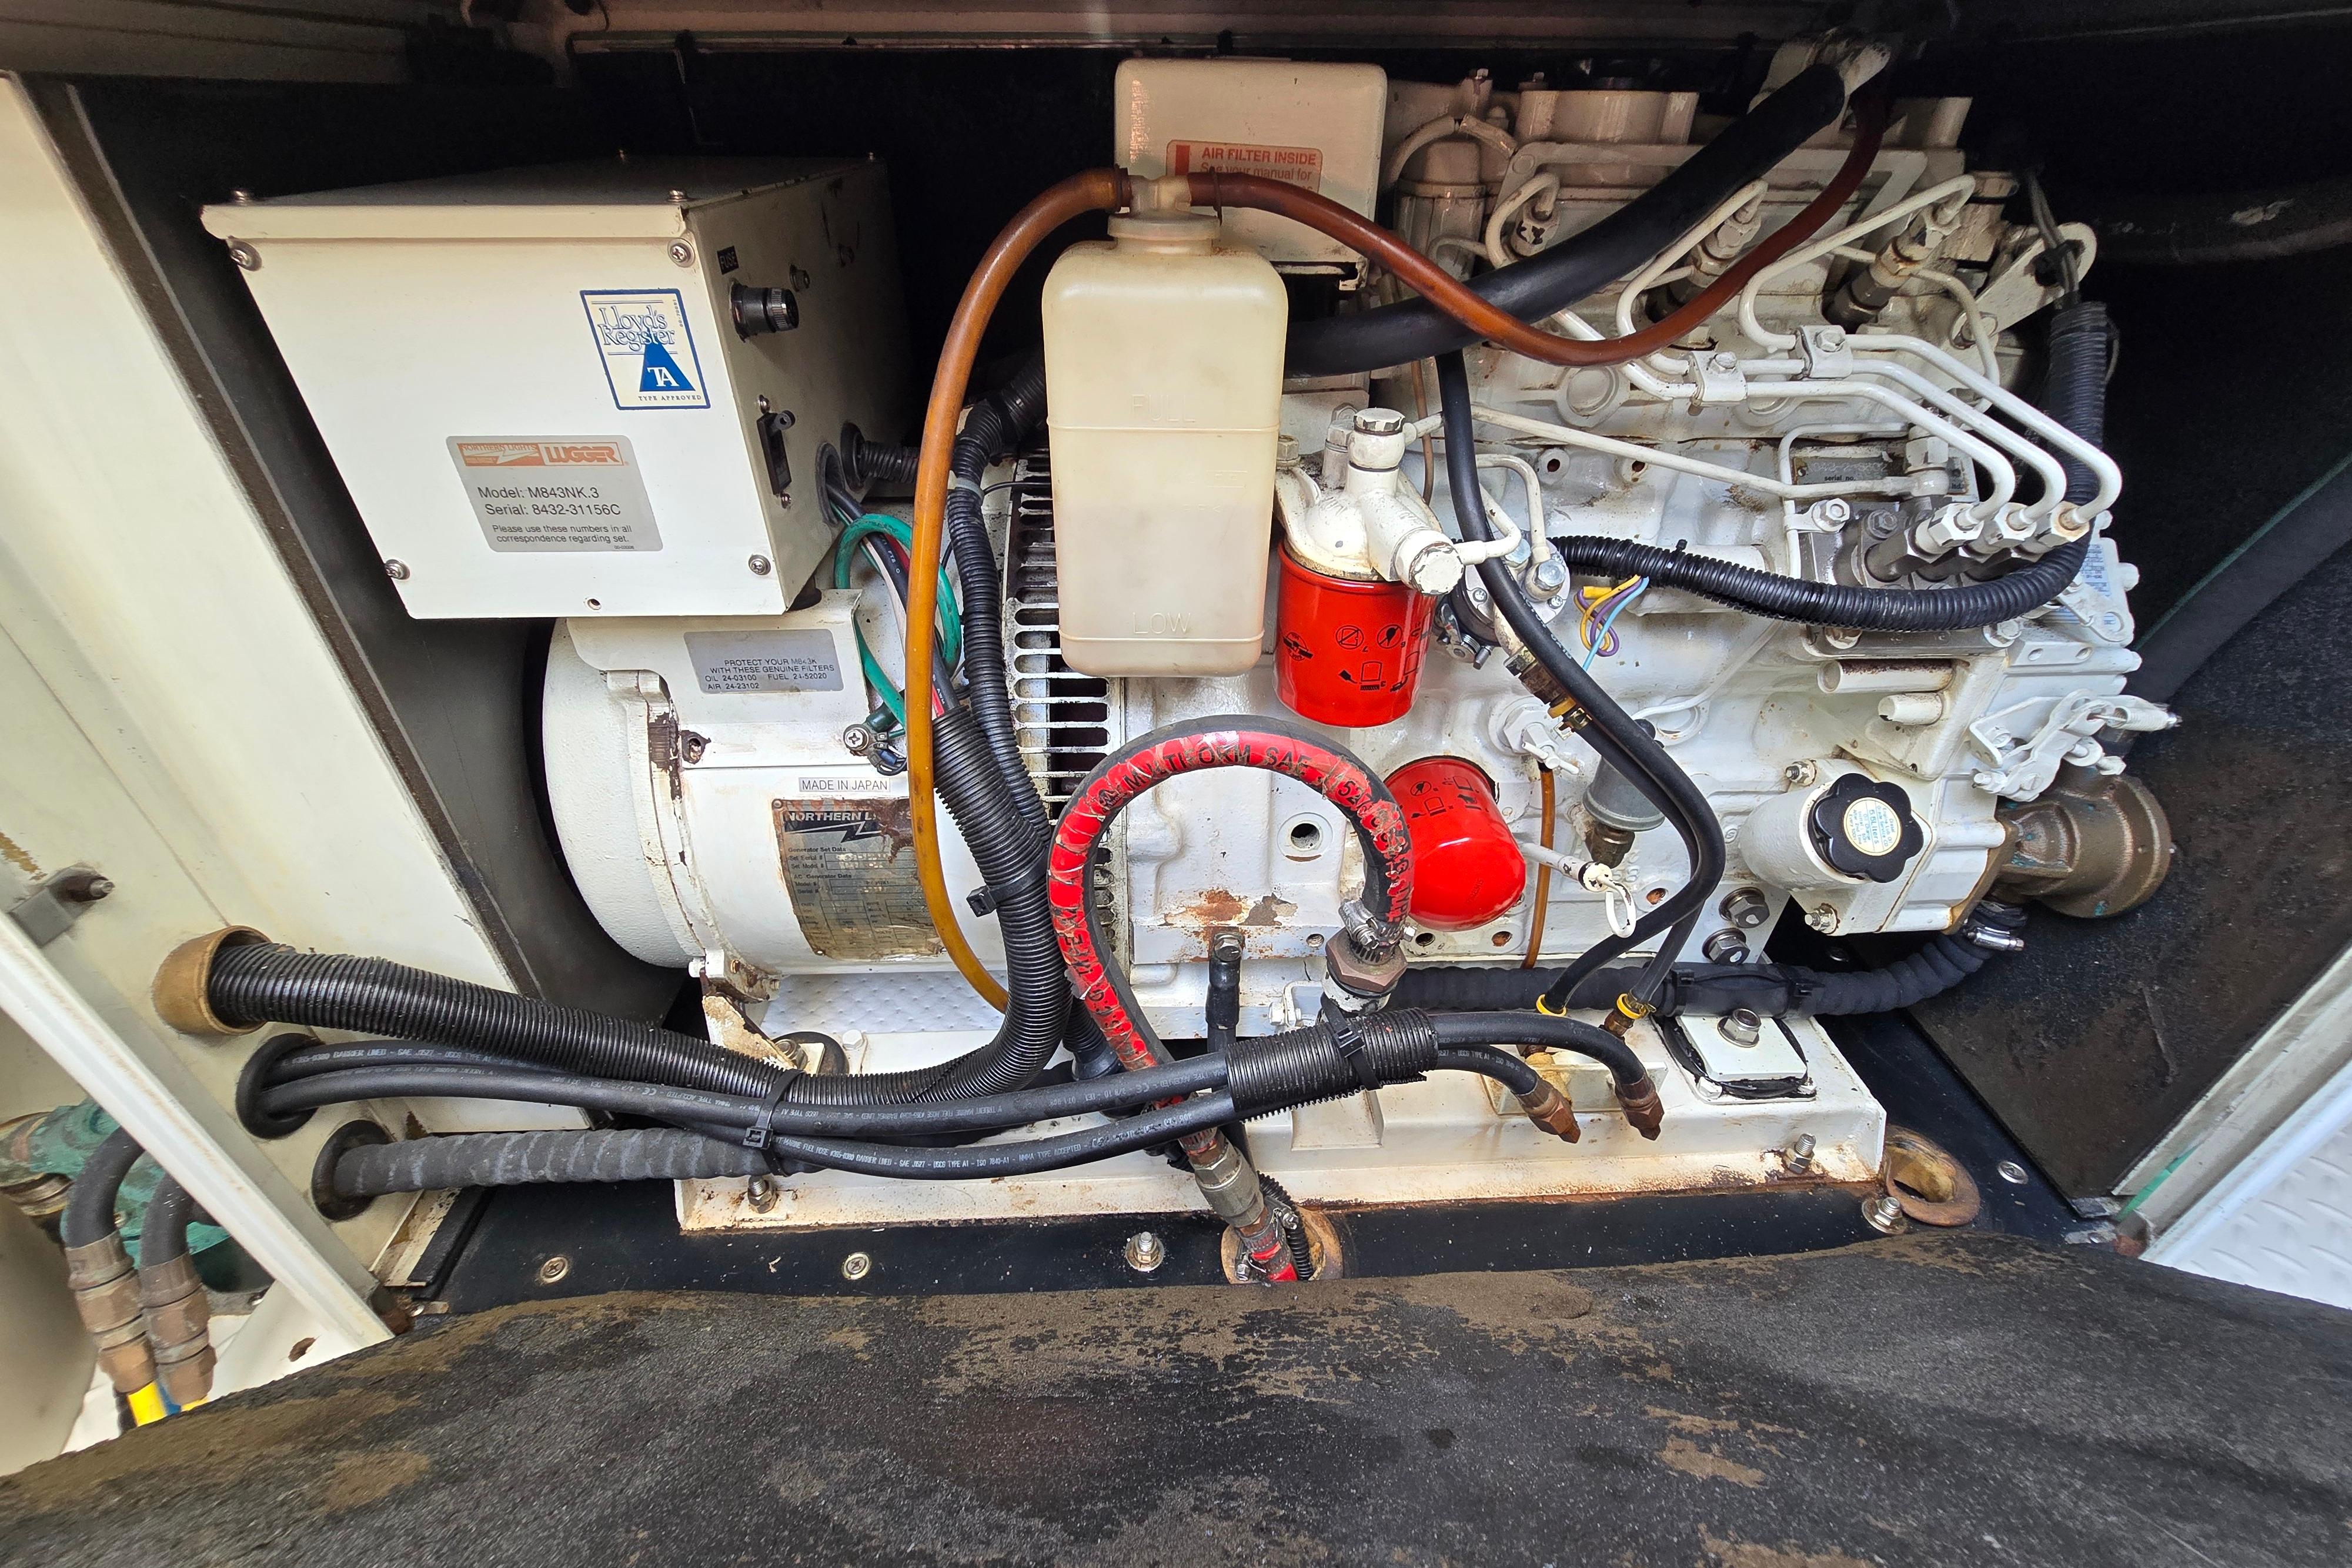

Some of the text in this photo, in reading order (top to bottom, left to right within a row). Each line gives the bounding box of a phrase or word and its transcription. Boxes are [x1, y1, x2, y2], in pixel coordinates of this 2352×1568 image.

[1202, 148, 1317, 165] AIR FILTER INSIDE
[1298, 168, 1312, 180] for
[719, 252, 737, 270] FUSE
[599, 305, 667, 331] Lloyd's
[597, 324, 675, 352] Register
[647, 367, 679, 387] TA
[1132, 394, 1196, 422] FULL
[545, 446, 621, 463] LUGGER
[477, 487, 599, 499] Model: M843NK.3
[485, 504, 621, 516] Serial: 8432-31156C
[492, 524, 523, 533] Please
[543, 524, 567, 533] these
[570, 524, 609, 533] numbers
[611, 524, 619, 533] in
[622, 524, 632, 533] all
[496, 534, 567, 544] correspondence
[569, 534, 611, 544] regarding
[1132, 612, 1191, 634] LOW
[802, 780, 887, 791] MADE IN JAPAN
[786, 812, 860, 821] NORTHERN
[803, 1144, 814, 1152] FUEL
[816, 1147, 830, 1156] HOSE
[1037, 1150, 1051, 1158] TYPE
[1054, 1144, 1081, 1156] ACCEPTED
